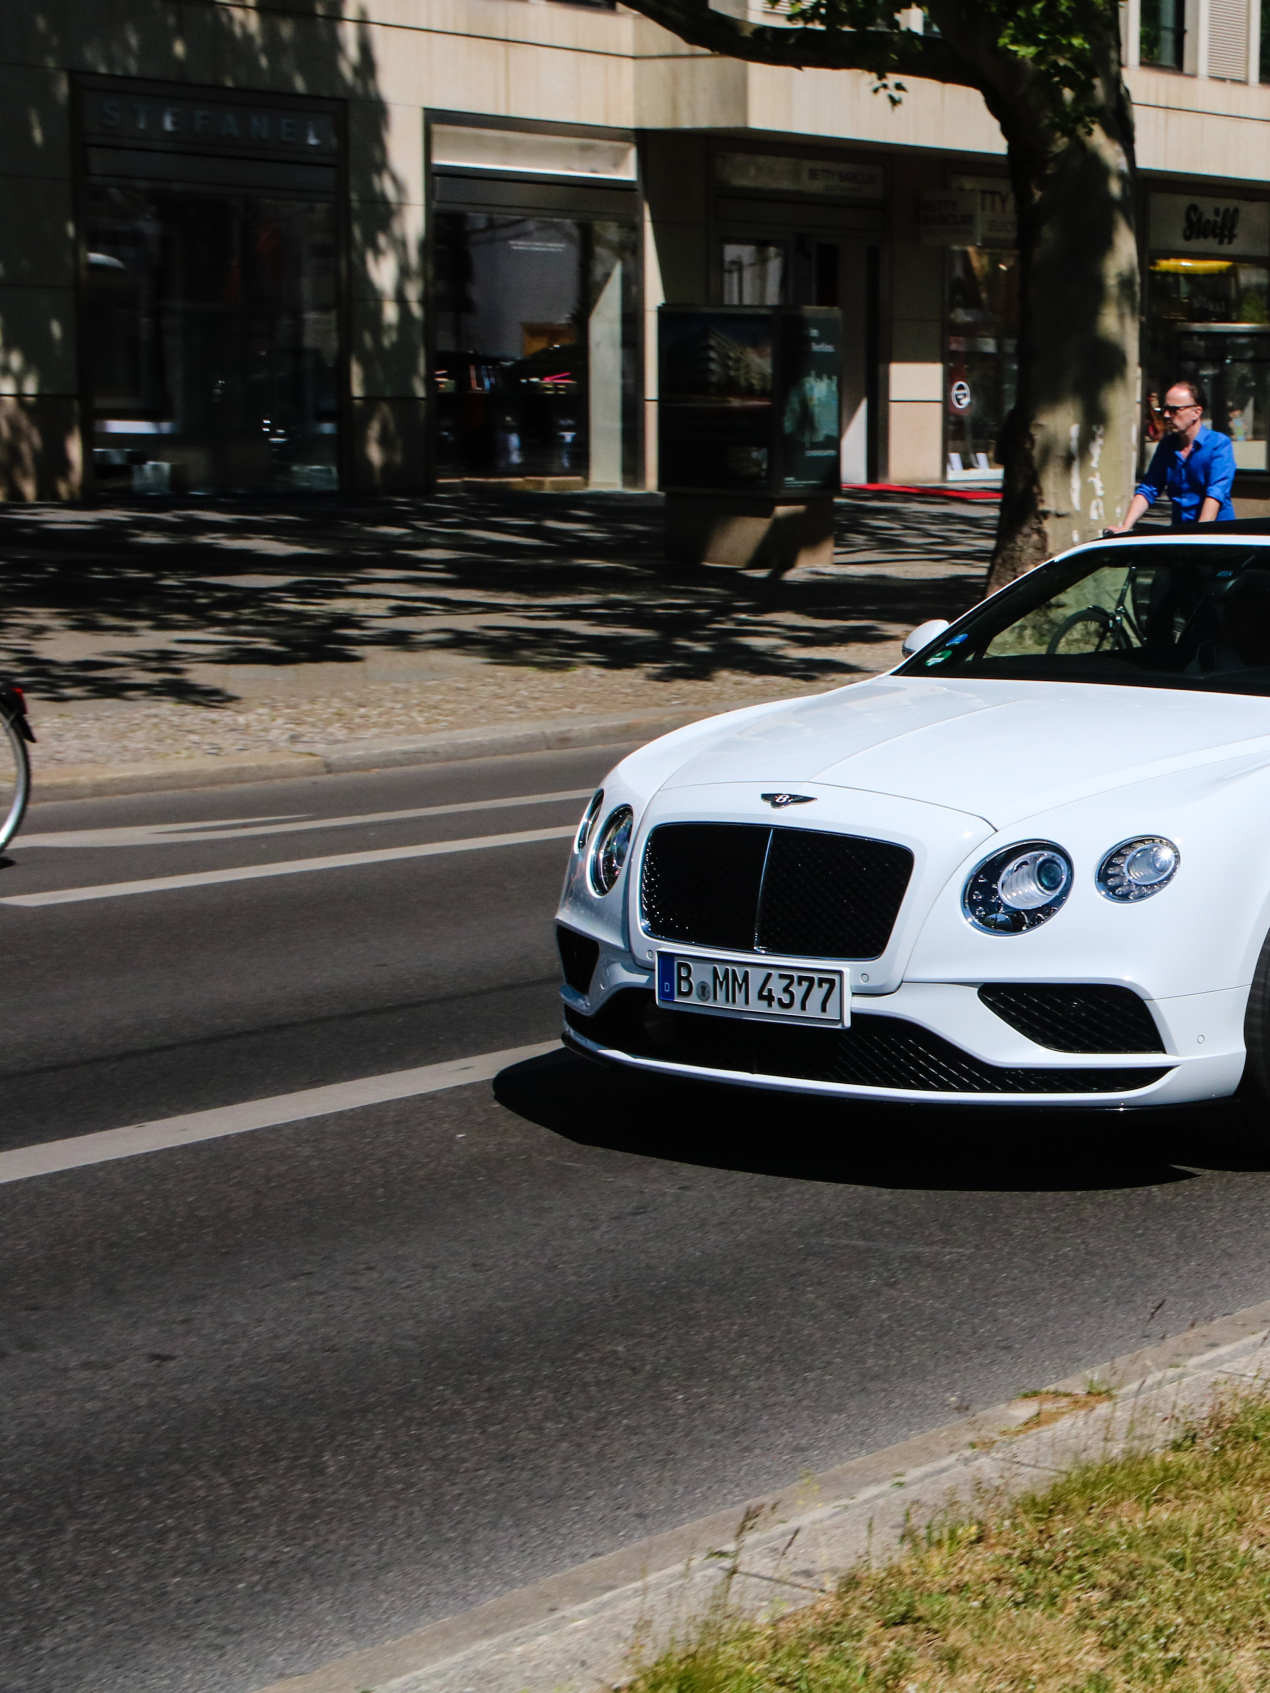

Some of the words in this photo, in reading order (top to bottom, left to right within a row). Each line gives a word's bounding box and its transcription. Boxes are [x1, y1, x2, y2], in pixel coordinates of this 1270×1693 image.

[99, 100, 321, 146] STEFANEL
[1183, 203, 1240, 245] Steiff
[676, 961, 694, 997] B
[712, 965, 750, 1005] MM
[757, 972, 836, 1013] 4377
